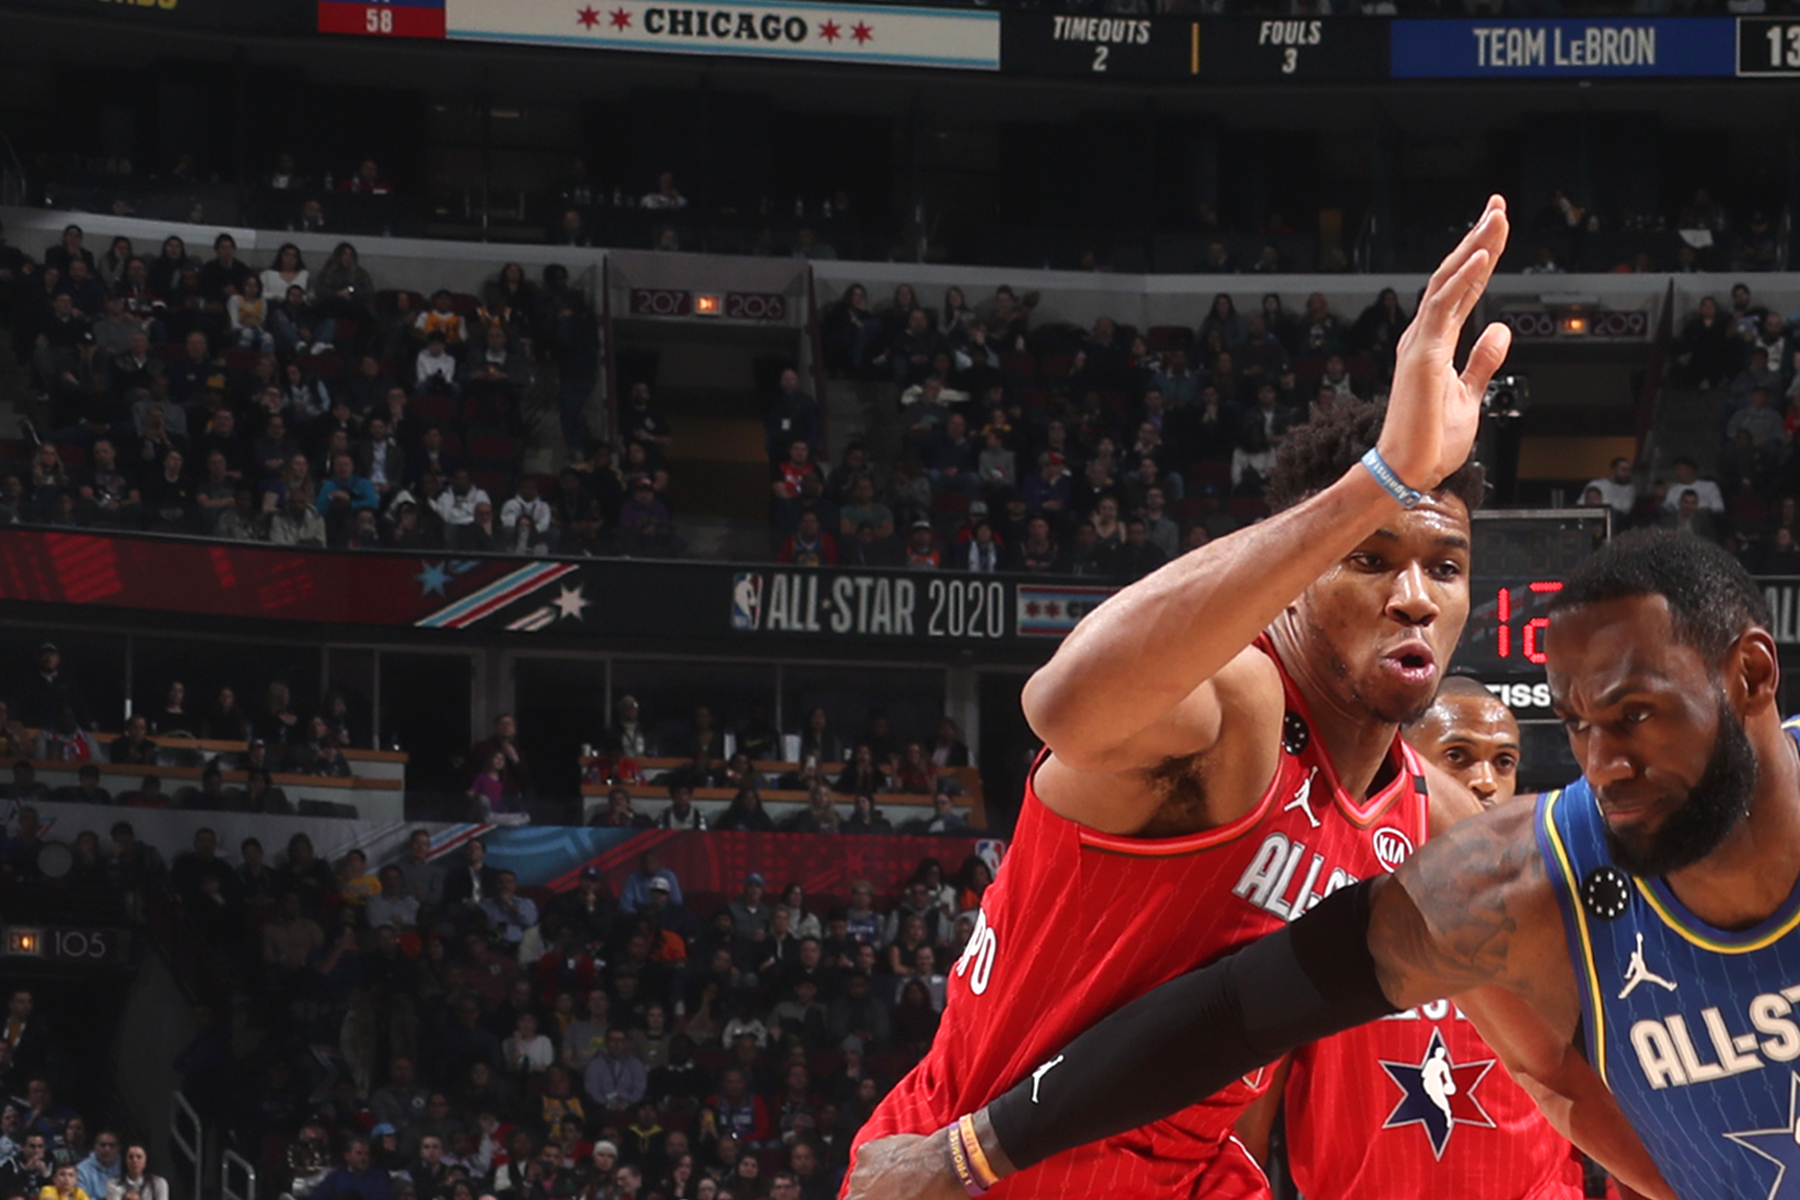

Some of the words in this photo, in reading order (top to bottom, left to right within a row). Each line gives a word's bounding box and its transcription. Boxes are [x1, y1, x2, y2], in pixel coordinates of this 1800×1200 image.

[365, 8, 393, 33] 58
[643, 8, 808, 43] CHICAGO
[1053, 16, 1152, 45] TIMEOUTS
[1258, 21, 1323, 46] FOULS
[1092, 46, 1110, 71] 2
[1472, 27, 1546, 66] TEAM
[1281, 47, 1299, 74] 3
[927, 578, 1005, 638] 2020
[55, 930, 107, 957] 105
